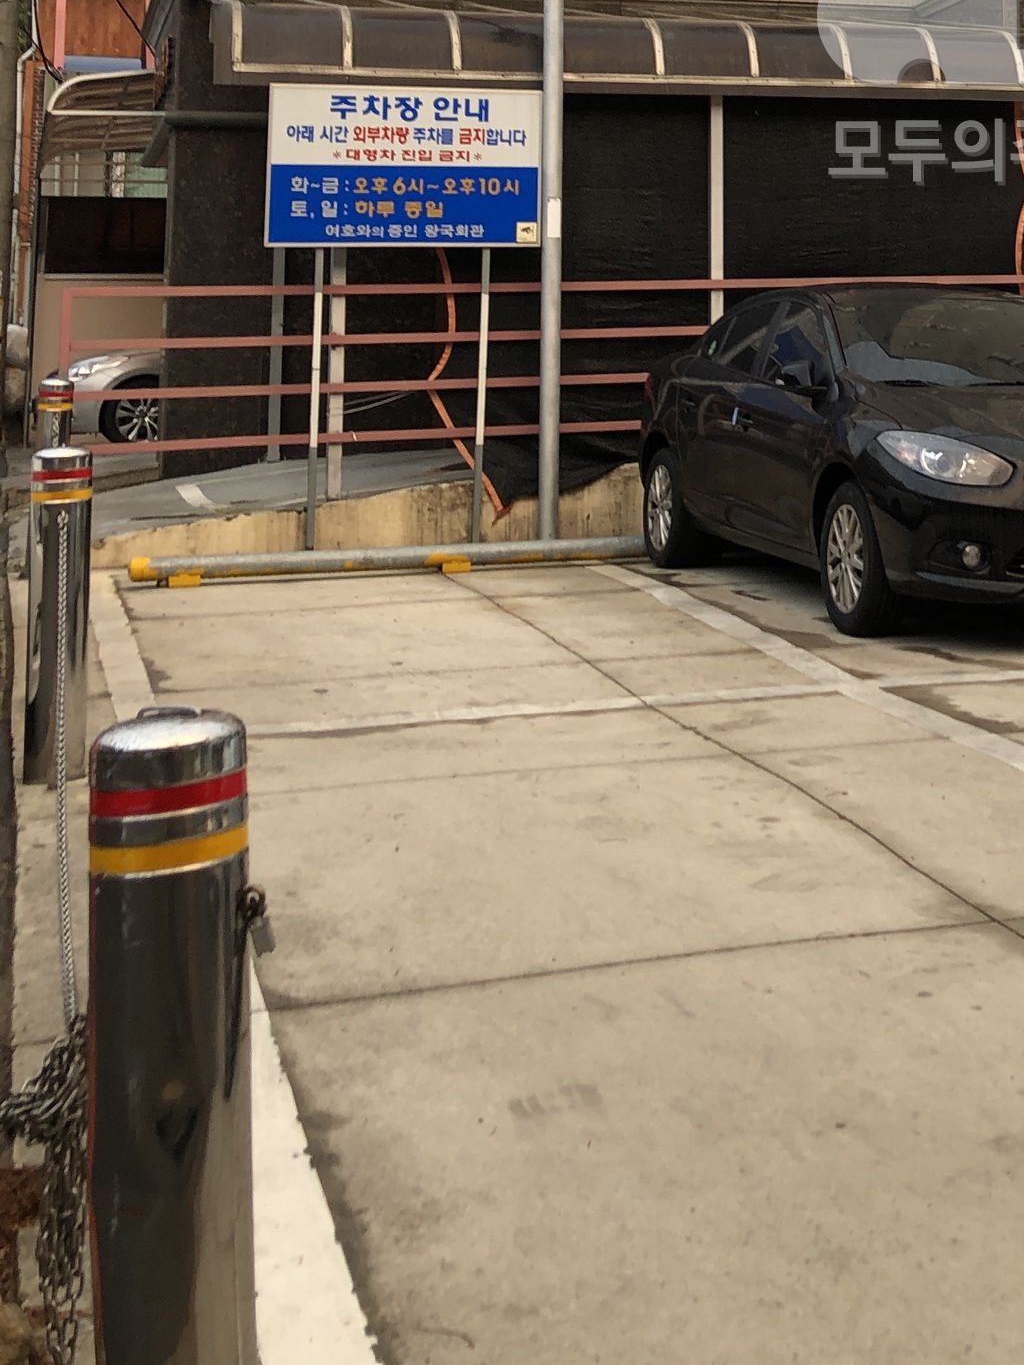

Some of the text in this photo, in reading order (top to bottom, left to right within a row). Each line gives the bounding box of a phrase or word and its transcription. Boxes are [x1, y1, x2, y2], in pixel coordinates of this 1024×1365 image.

[330, 95, 489, 122] 주차장 안내
[286, 125, 527, 146] 아래 시간 외부차량 주차를 금지합니다
[401, 149, 432, 162] 진입
[355, 200, 395, 218] 하루
[404, 200, 444, 219] 종일
[325, 224, 384, 238] 여호와의
[424, 224, 485, 238] 왕국회관
